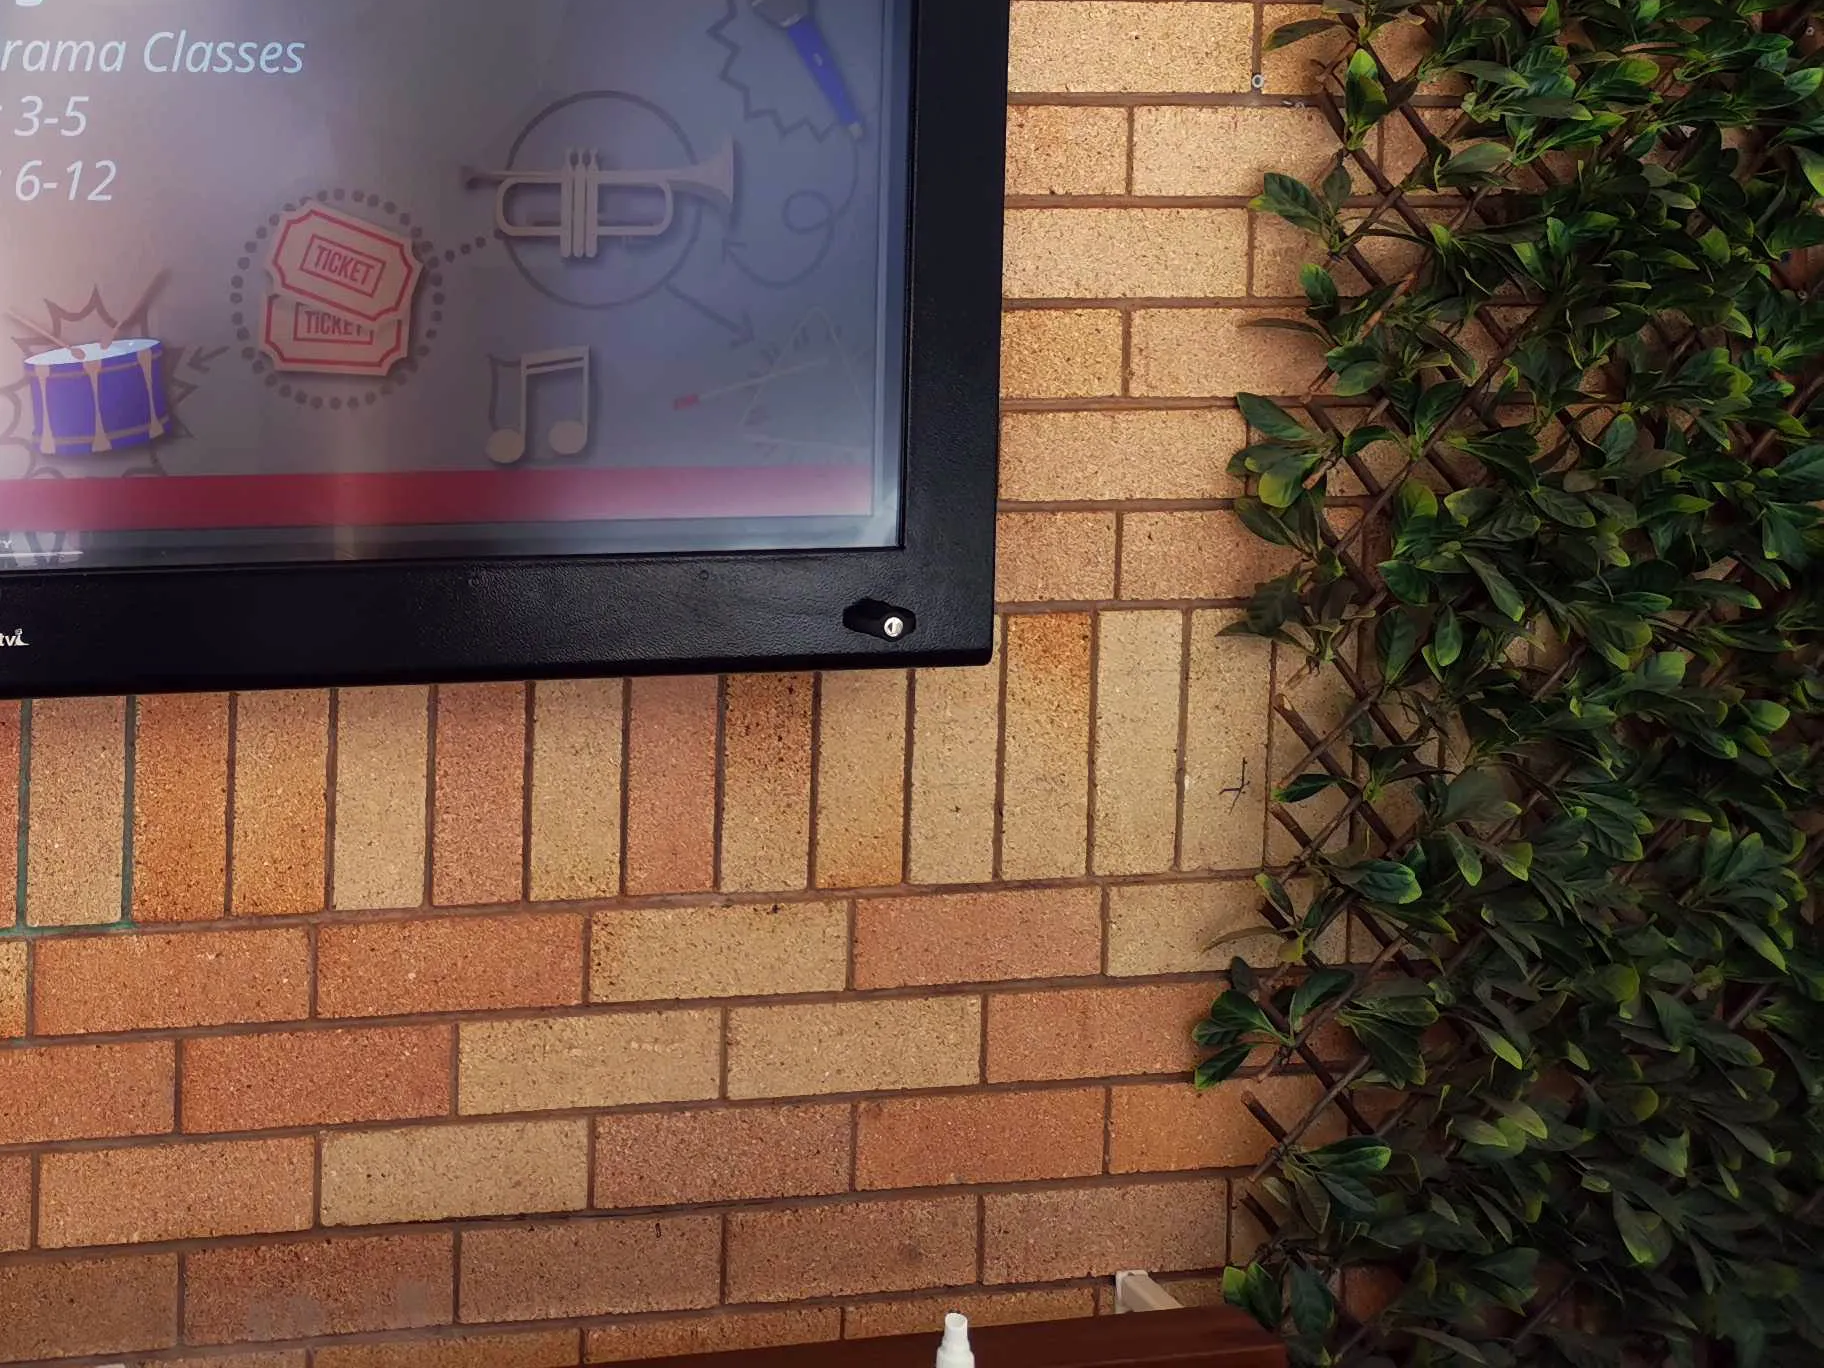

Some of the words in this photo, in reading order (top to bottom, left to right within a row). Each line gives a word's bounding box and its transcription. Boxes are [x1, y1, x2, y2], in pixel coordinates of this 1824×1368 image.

[141, 30, 306, 76] Classes
[12, 95, 90, 137] 3-5
[14, 159, 116, 201] 6-12
[314, 244, 374, 286] TICKET
